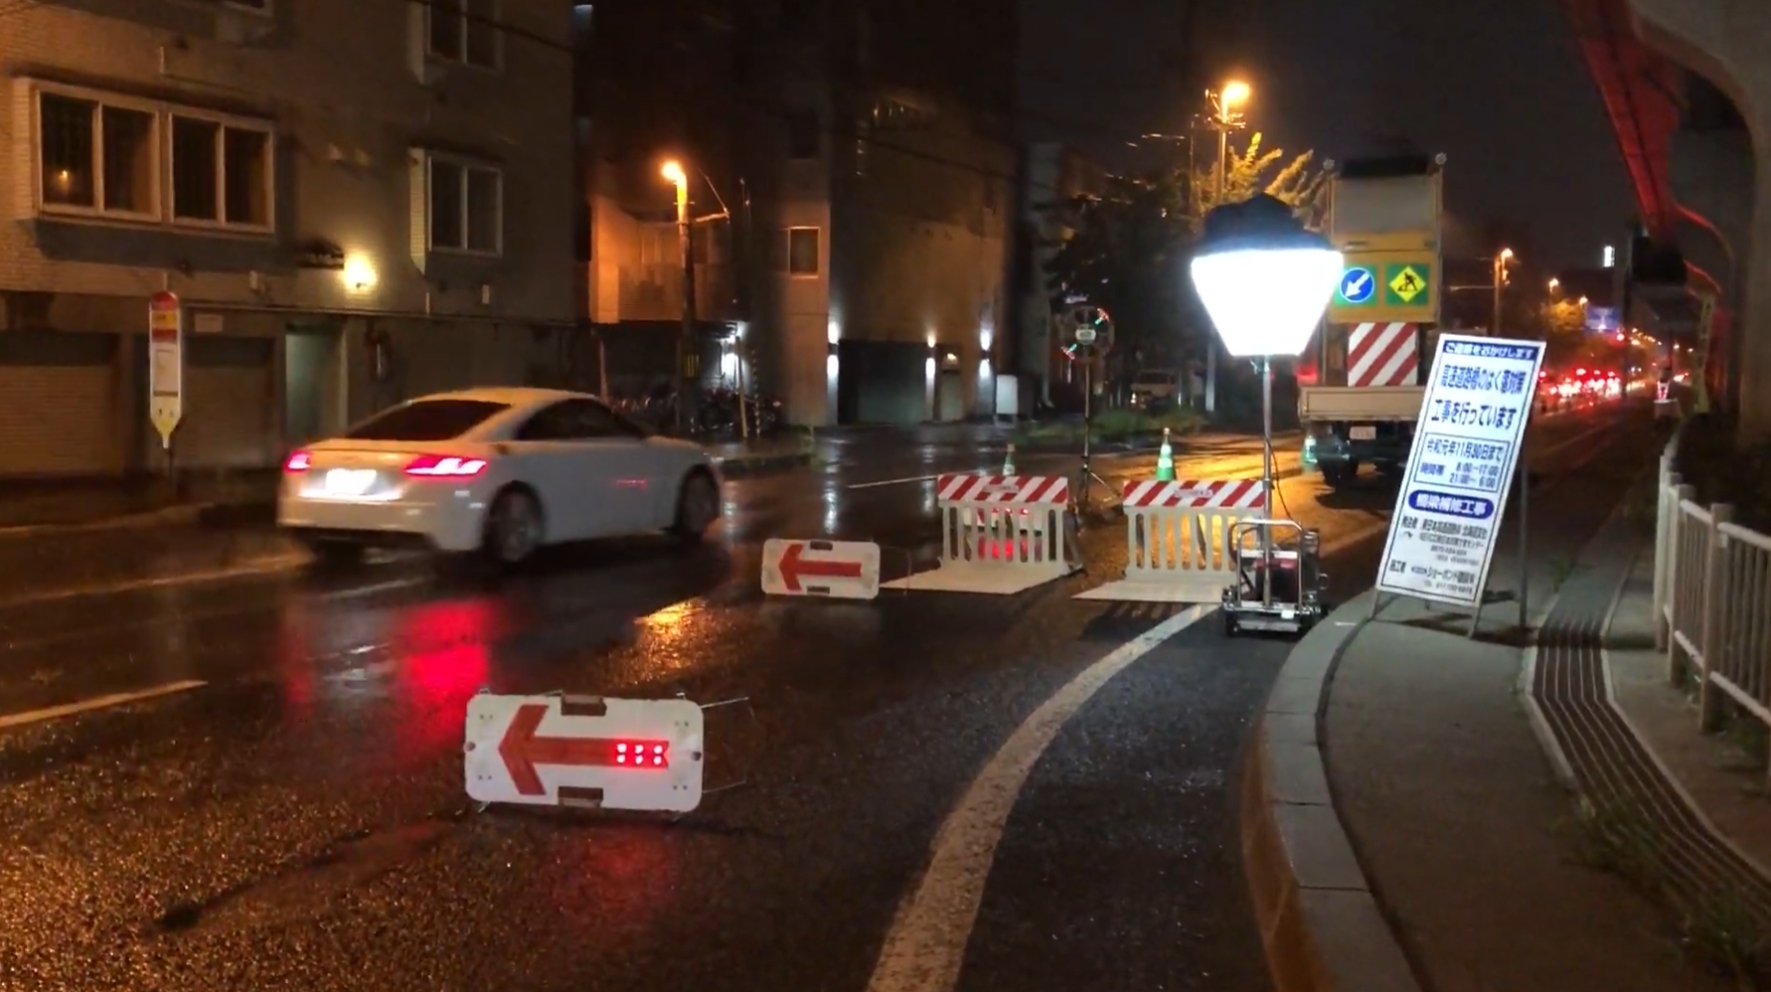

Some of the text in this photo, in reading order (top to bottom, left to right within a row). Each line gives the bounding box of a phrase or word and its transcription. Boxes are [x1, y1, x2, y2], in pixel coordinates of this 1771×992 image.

[1431, 399, 1517, 430] 工事を行っています
[1427, 439, 1504, 462] 令和元年11月30日まで
